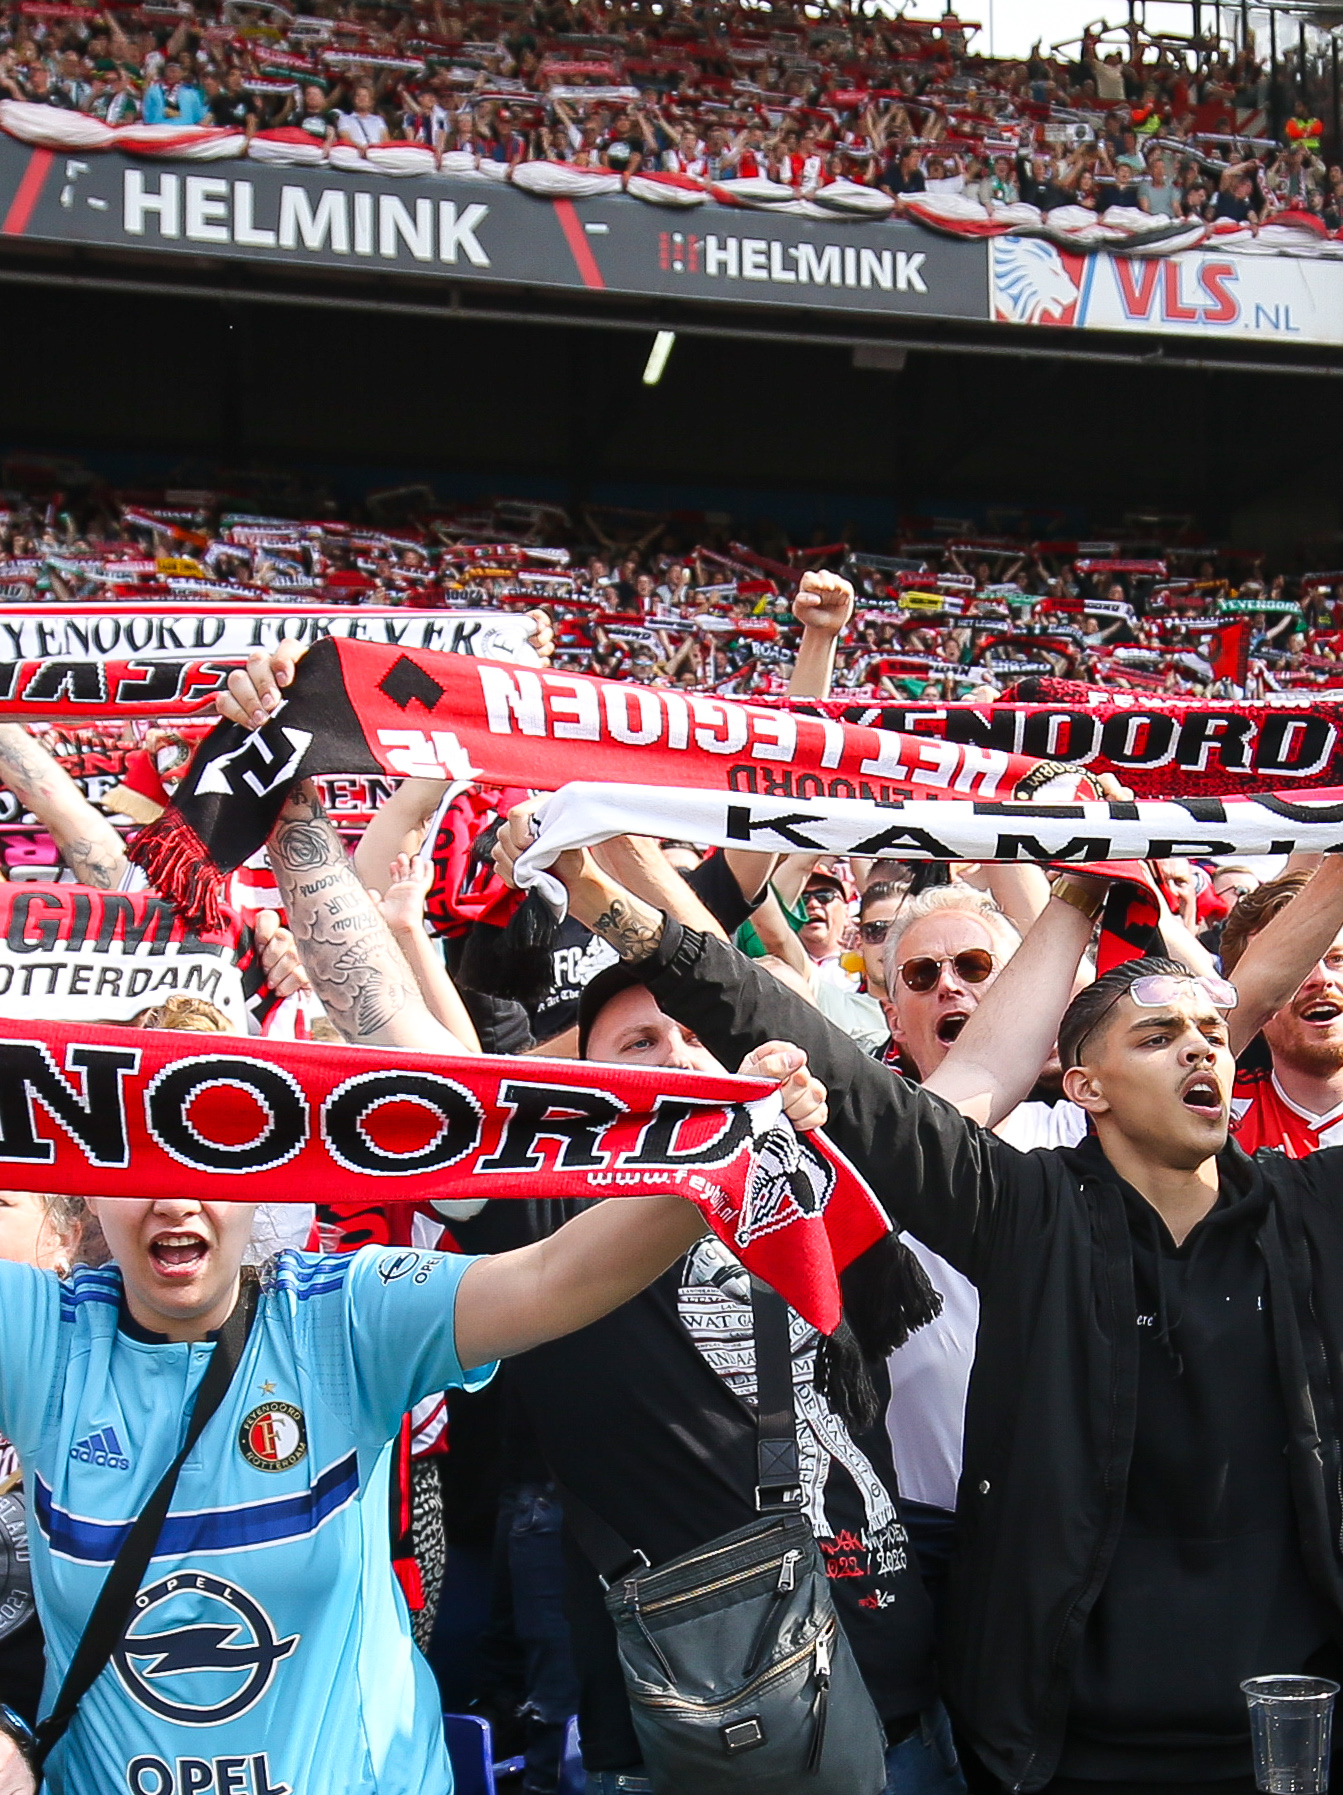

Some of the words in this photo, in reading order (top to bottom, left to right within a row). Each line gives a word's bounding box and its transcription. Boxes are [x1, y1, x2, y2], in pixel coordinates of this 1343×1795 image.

[122, 167, 491, 269] HELMINK
[704, 233, 930, 295] HELMINK
[251, 616, 482, 655] FOREVER
[477, 664, 846, 769] LEGIOEN
[860, 728, 1009, 797] HET
[6, 892, 224, 957] GIM
[243, 1402, 302, 1430] FEYENOORD
[68, 1446, 130, 1472] adidas
[245, 1441, 307, 1470] ROTTERDAM
[136, 1576, 236, 1609] OPEL
[127, 1753, 293, 1795] OPEL
